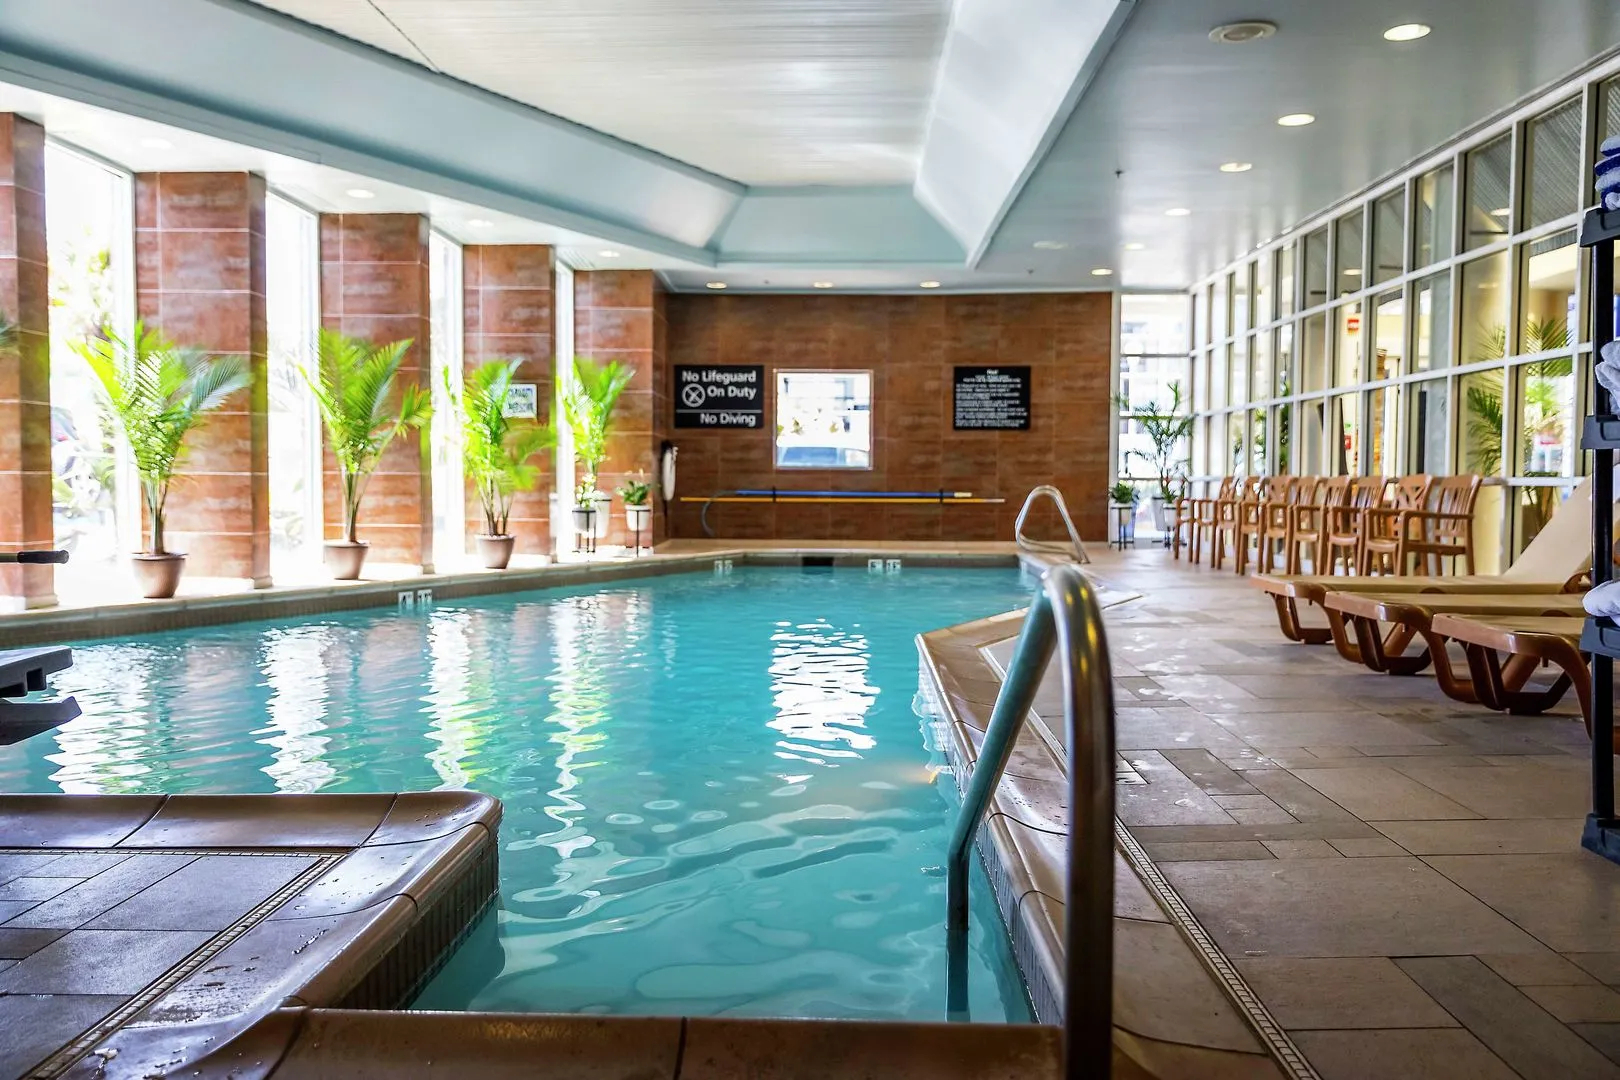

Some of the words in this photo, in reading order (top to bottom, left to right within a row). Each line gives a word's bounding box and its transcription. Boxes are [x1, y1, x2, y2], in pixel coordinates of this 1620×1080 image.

[682, 370, 699, 382] No
[702, 369, 757, 385] Lifeguard
[707, 385, 725, 397] On
[728, 385, 757, 400] Duty
[700, 413, 718, 424] No
[720, 413, 756, 427] Diving
